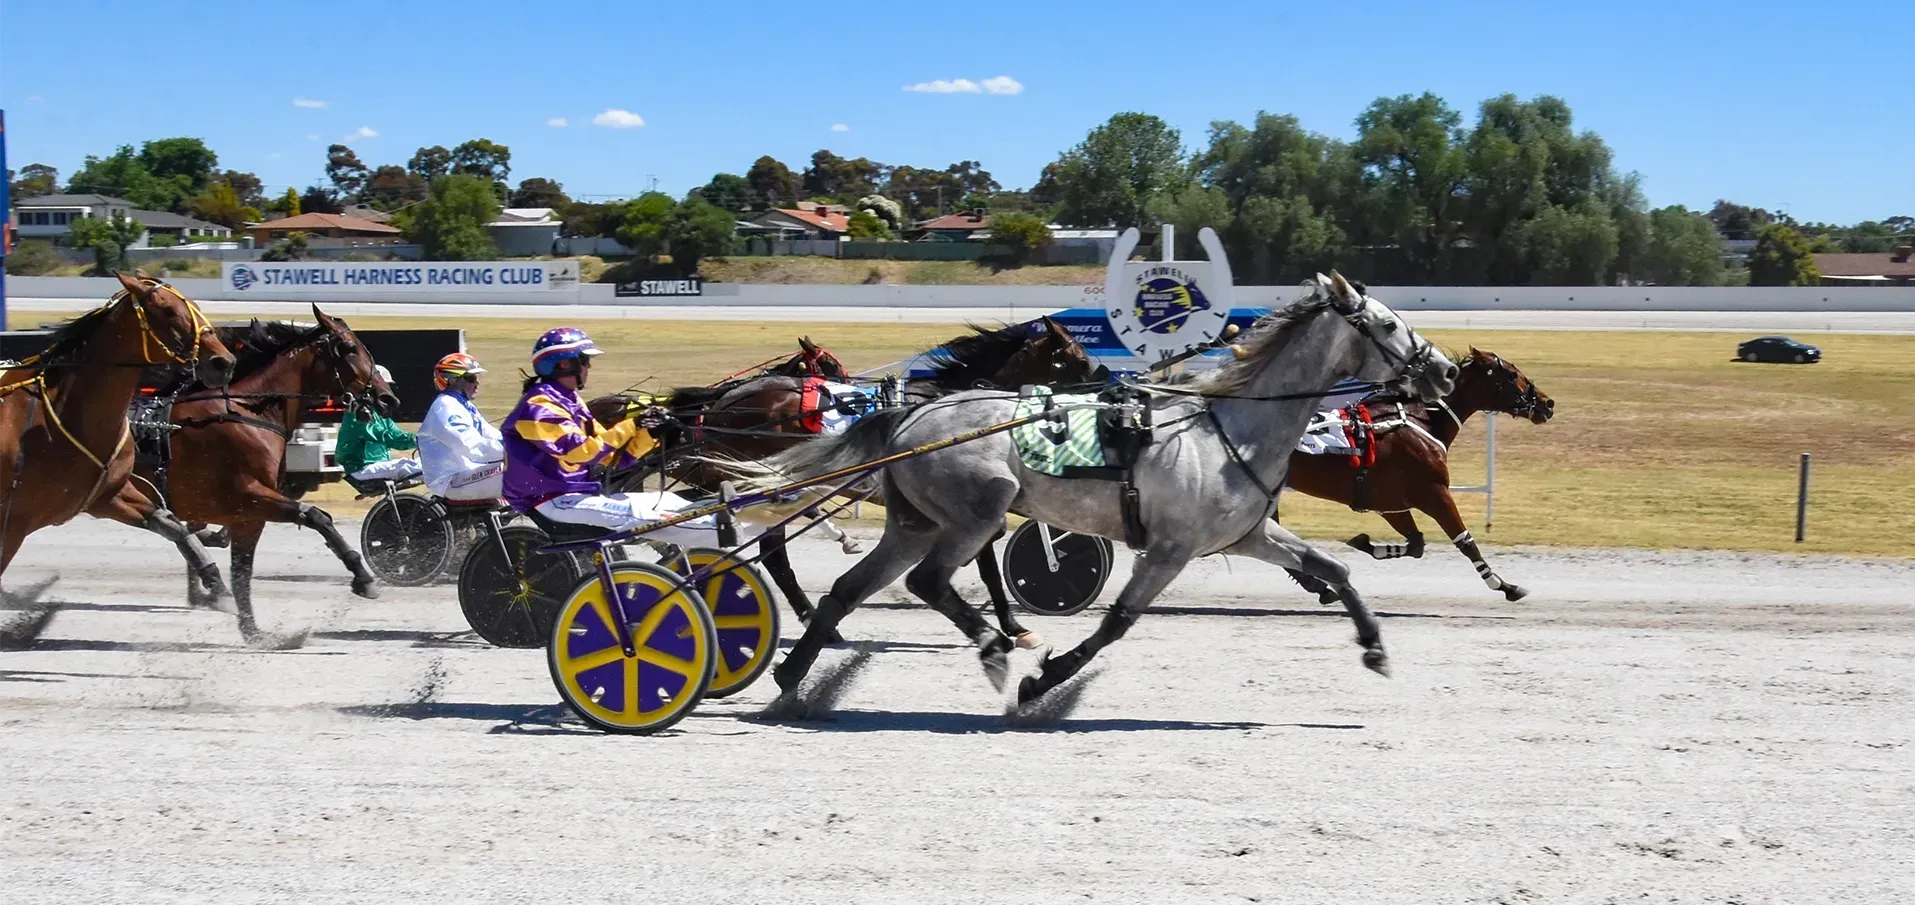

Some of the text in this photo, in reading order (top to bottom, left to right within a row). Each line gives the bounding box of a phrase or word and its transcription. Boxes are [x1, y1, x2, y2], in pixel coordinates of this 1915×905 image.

[263, 268, 339, 285] STAWELL
[344, 268, 422, 285] HARNESS
[428, 268, 493, 285] RACING
[499, 268, 543, 285] CLUB
[640, 280, 700, 294] STAWELL
